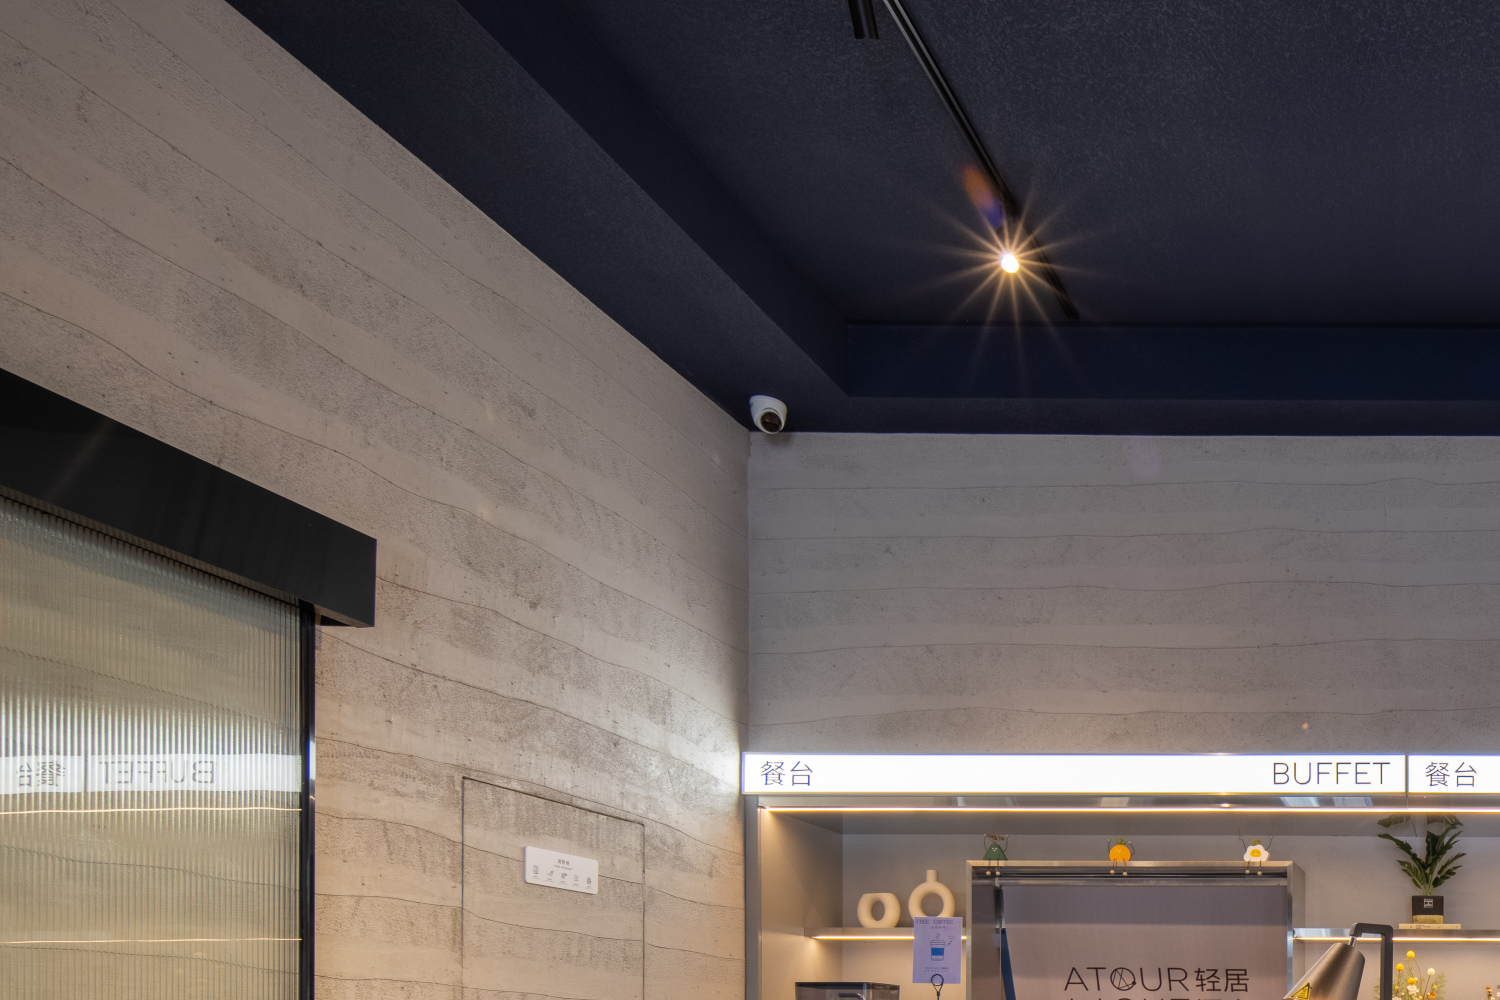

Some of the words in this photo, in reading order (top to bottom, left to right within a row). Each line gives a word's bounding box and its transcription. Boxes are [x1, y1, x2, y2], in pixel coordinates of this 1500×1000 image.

[761, 761, 812, 786] 餐台
[1273, 762, 1390, 785] BUFFET
[1425, 761, 1477, 787] 餐台
[1064, 967, 1189, 991] ATOUR
[1195, 967, 1249, 992] 轻居
